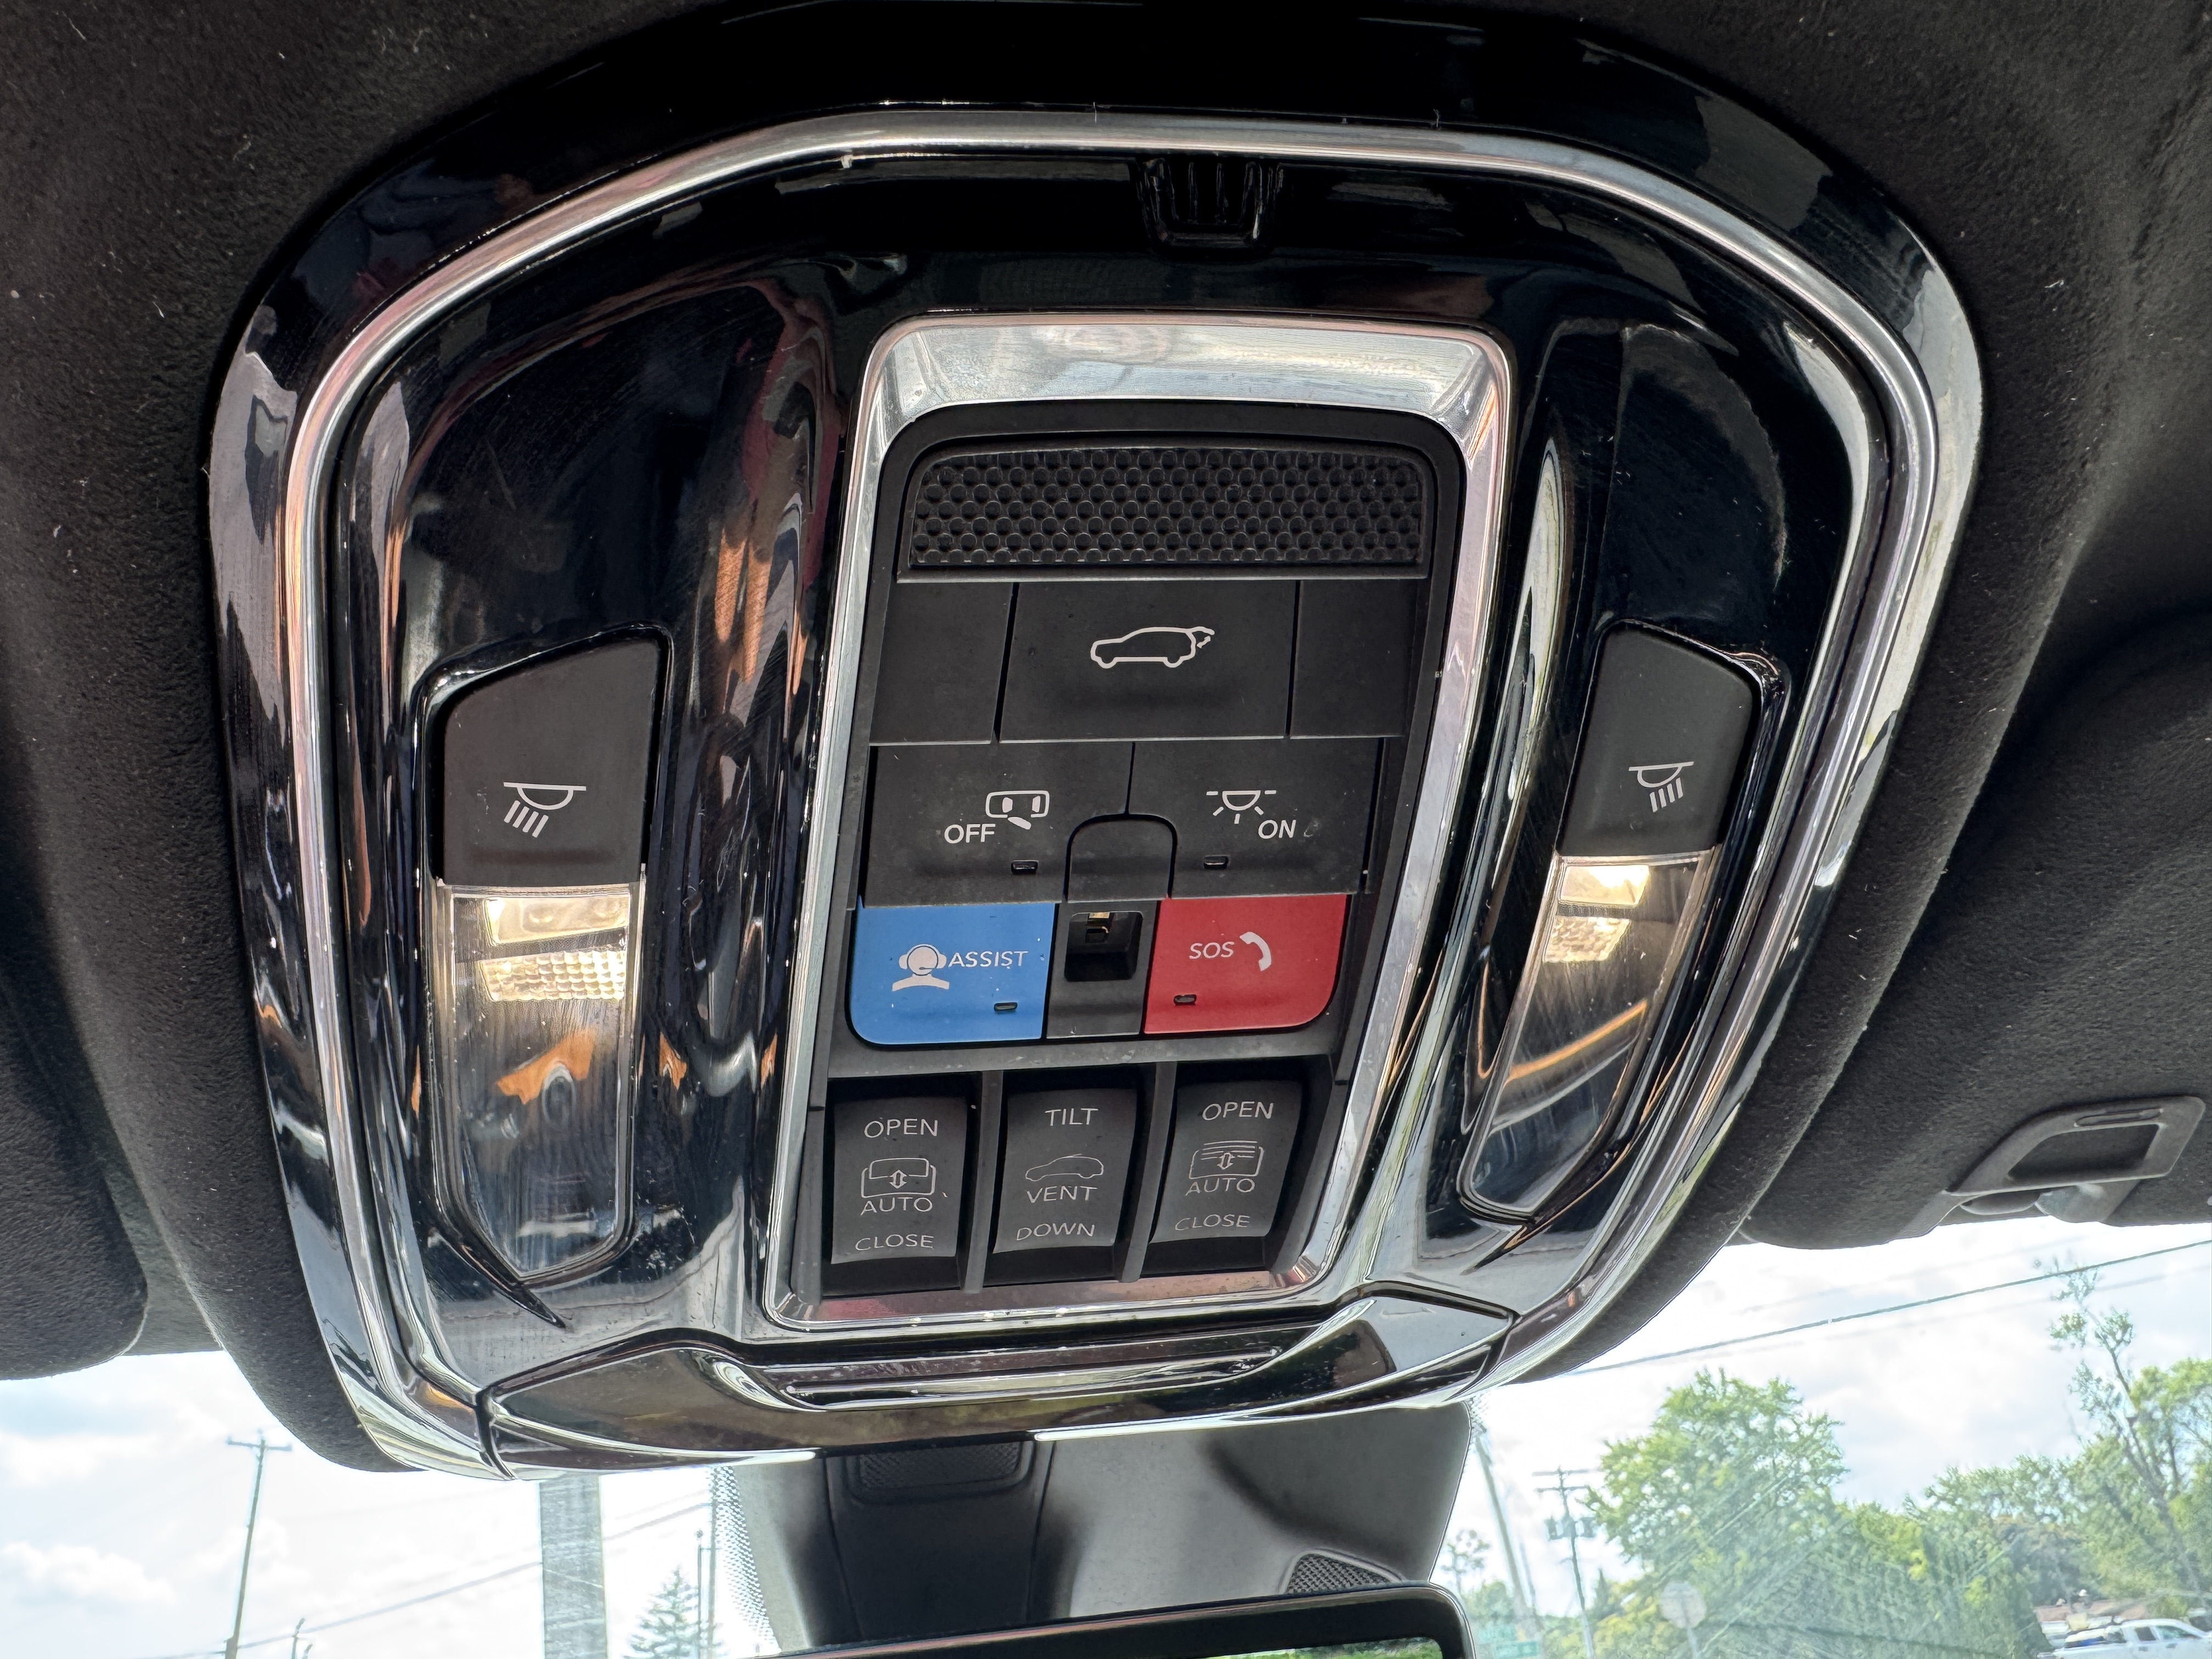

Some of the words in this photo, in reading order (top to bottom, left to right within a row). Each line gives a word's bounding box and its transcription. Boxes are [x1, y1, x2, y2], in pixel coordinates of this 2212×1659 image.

[945, 824, 995, 843] OFF
[1259, 820, 1296, 839] ON
[1189, 941, 1234, 959] SOS
[948, 951, 1028, 968] ASSIST
[1045, 1108, 1098, 1126] TILT
[1203, 1102, 1273, 1121] OPEN
[865, 1119, 938, 1138] OPEN
[1027, 1186, 1097, 1203] VENT
[1186, 1177, 1255, 1196] AUTO
[861, 1197, 932, 1215] AUTO
[1017, 1222, 1094, 1241] DOWN
[1175, 1214, 1250, 1231] CLOSE
[855, 1234, 934, 1251] CLOSE
